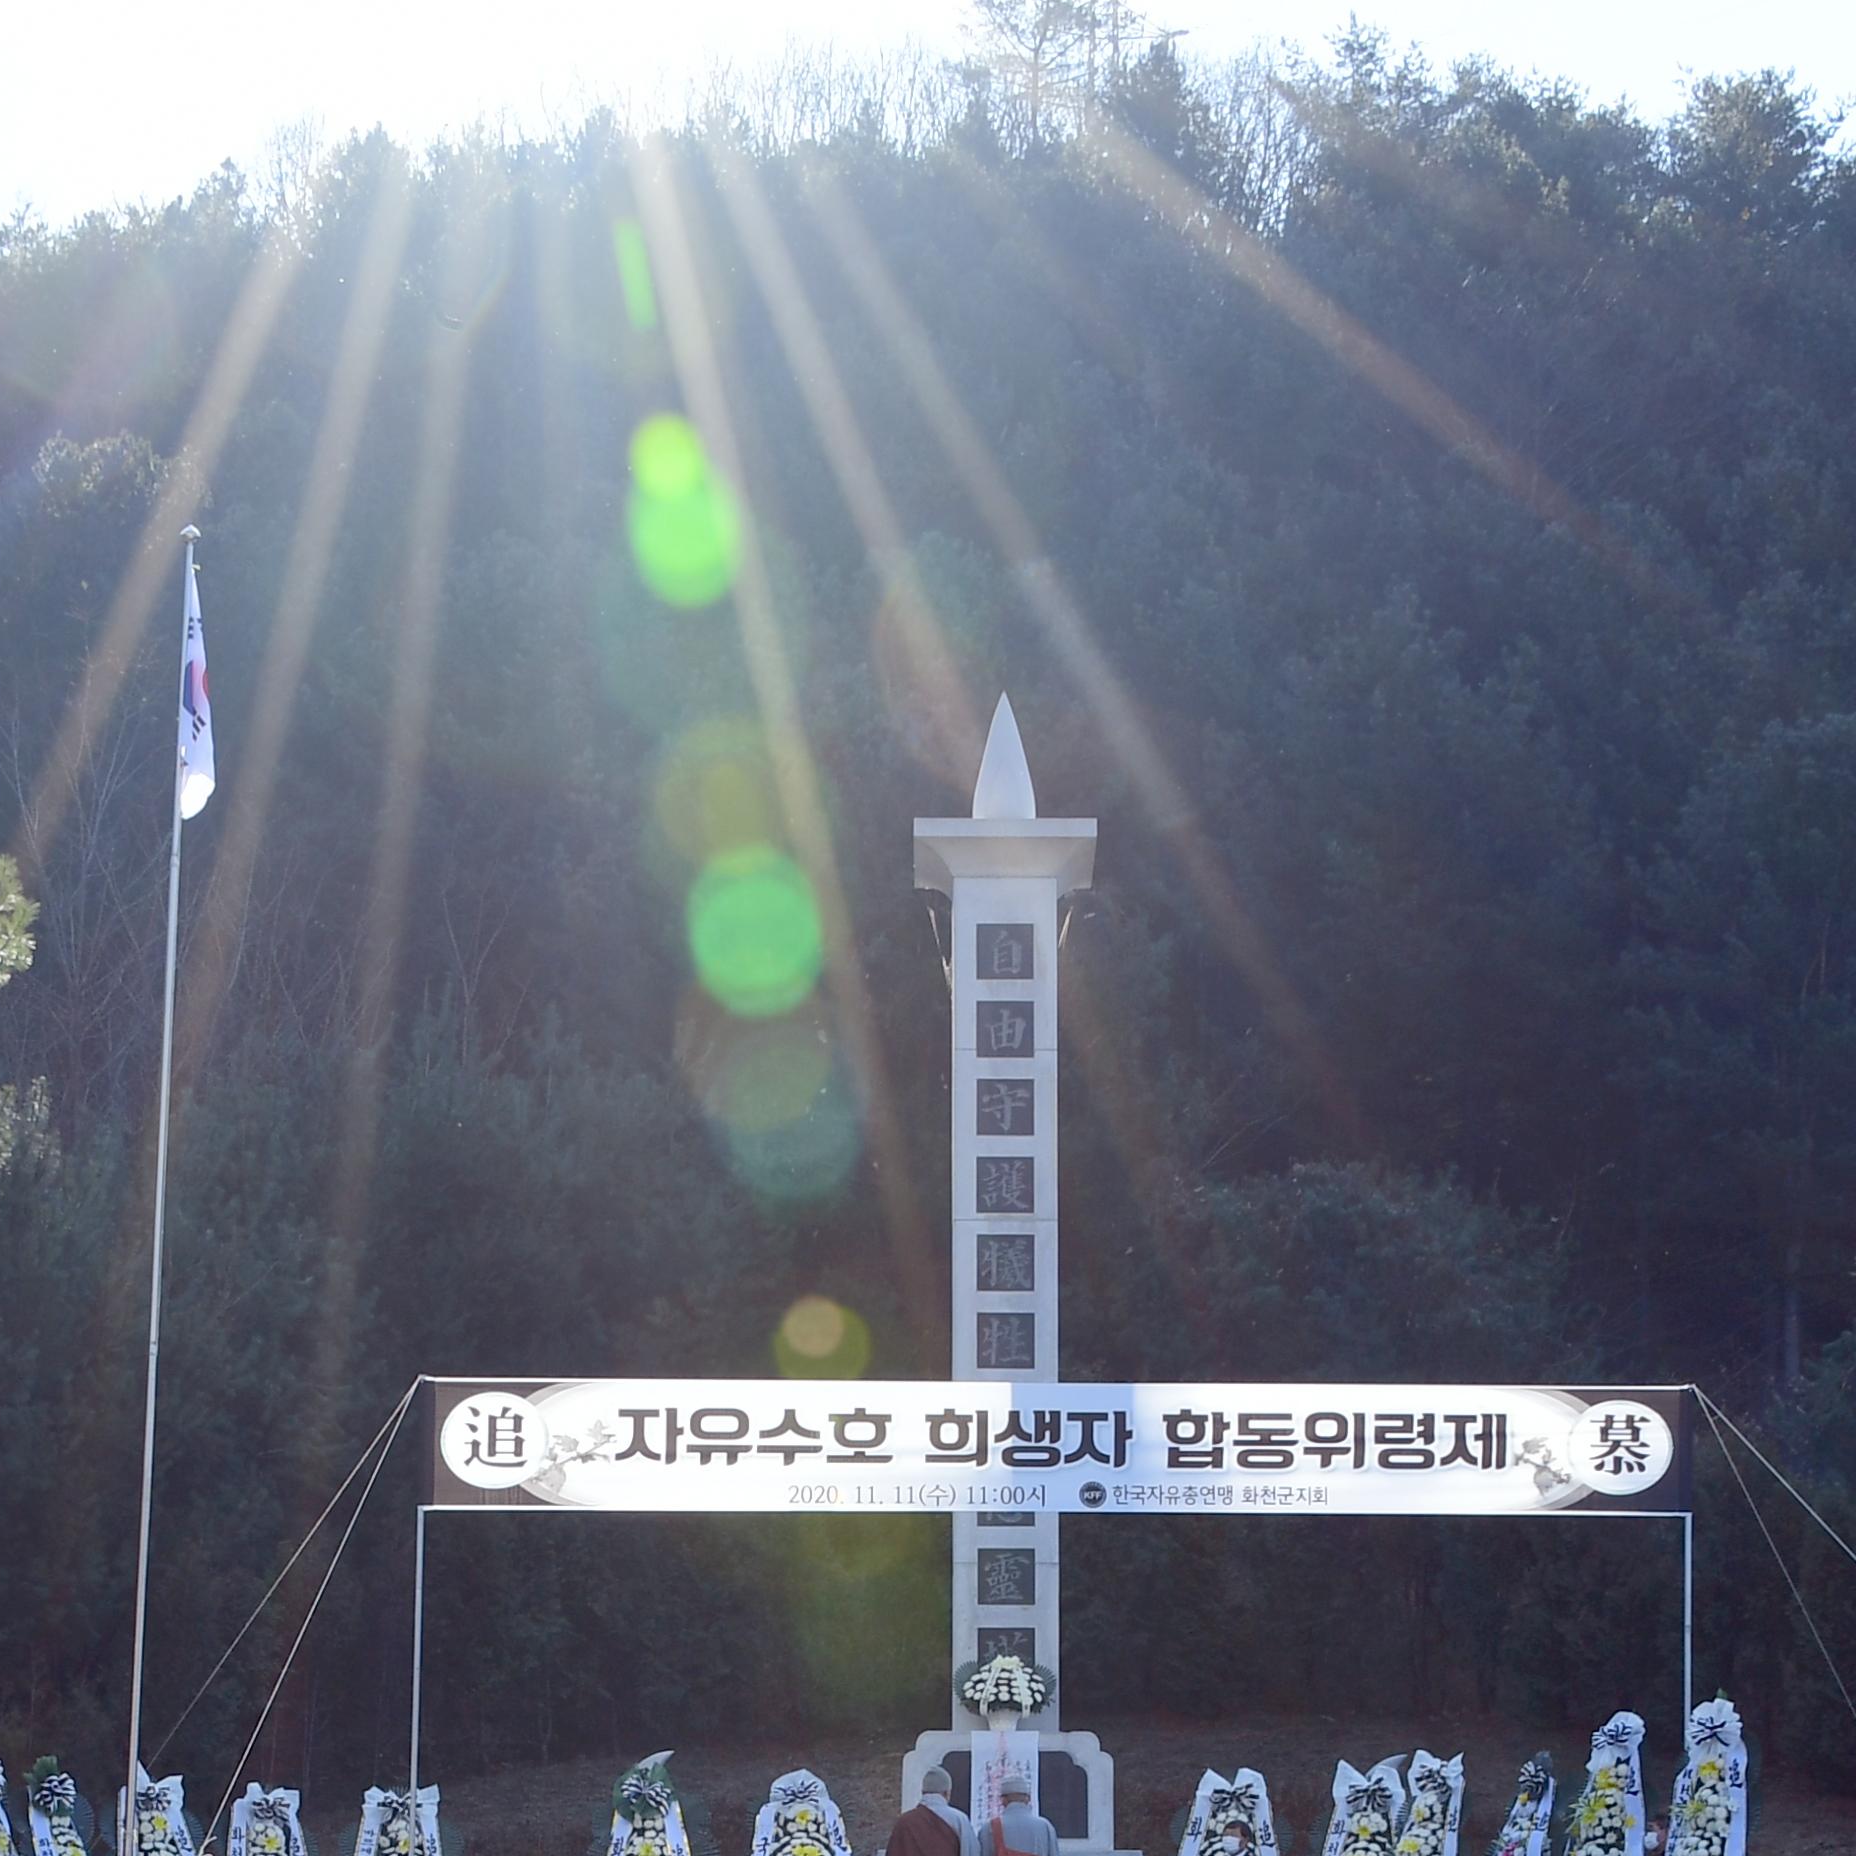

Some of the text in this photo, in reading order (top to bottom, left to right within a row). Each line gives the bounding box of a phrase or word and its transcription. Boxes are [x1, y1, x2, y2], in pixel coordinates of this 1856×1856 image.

[464, 1406, 528, 1467] 追
[615, 1407, 1507, 1470] 자유수호 희생자 합동위령제
[1589, 1414, 1651, 1475] 慕
[788, 1483, 1046, 1507] 2020. 11. 11(수) 11:00시
[1112, 1484, 1233, 1506] 한국자유총연맹
[1242, 1485, 1328, 1507] 화천군지회
